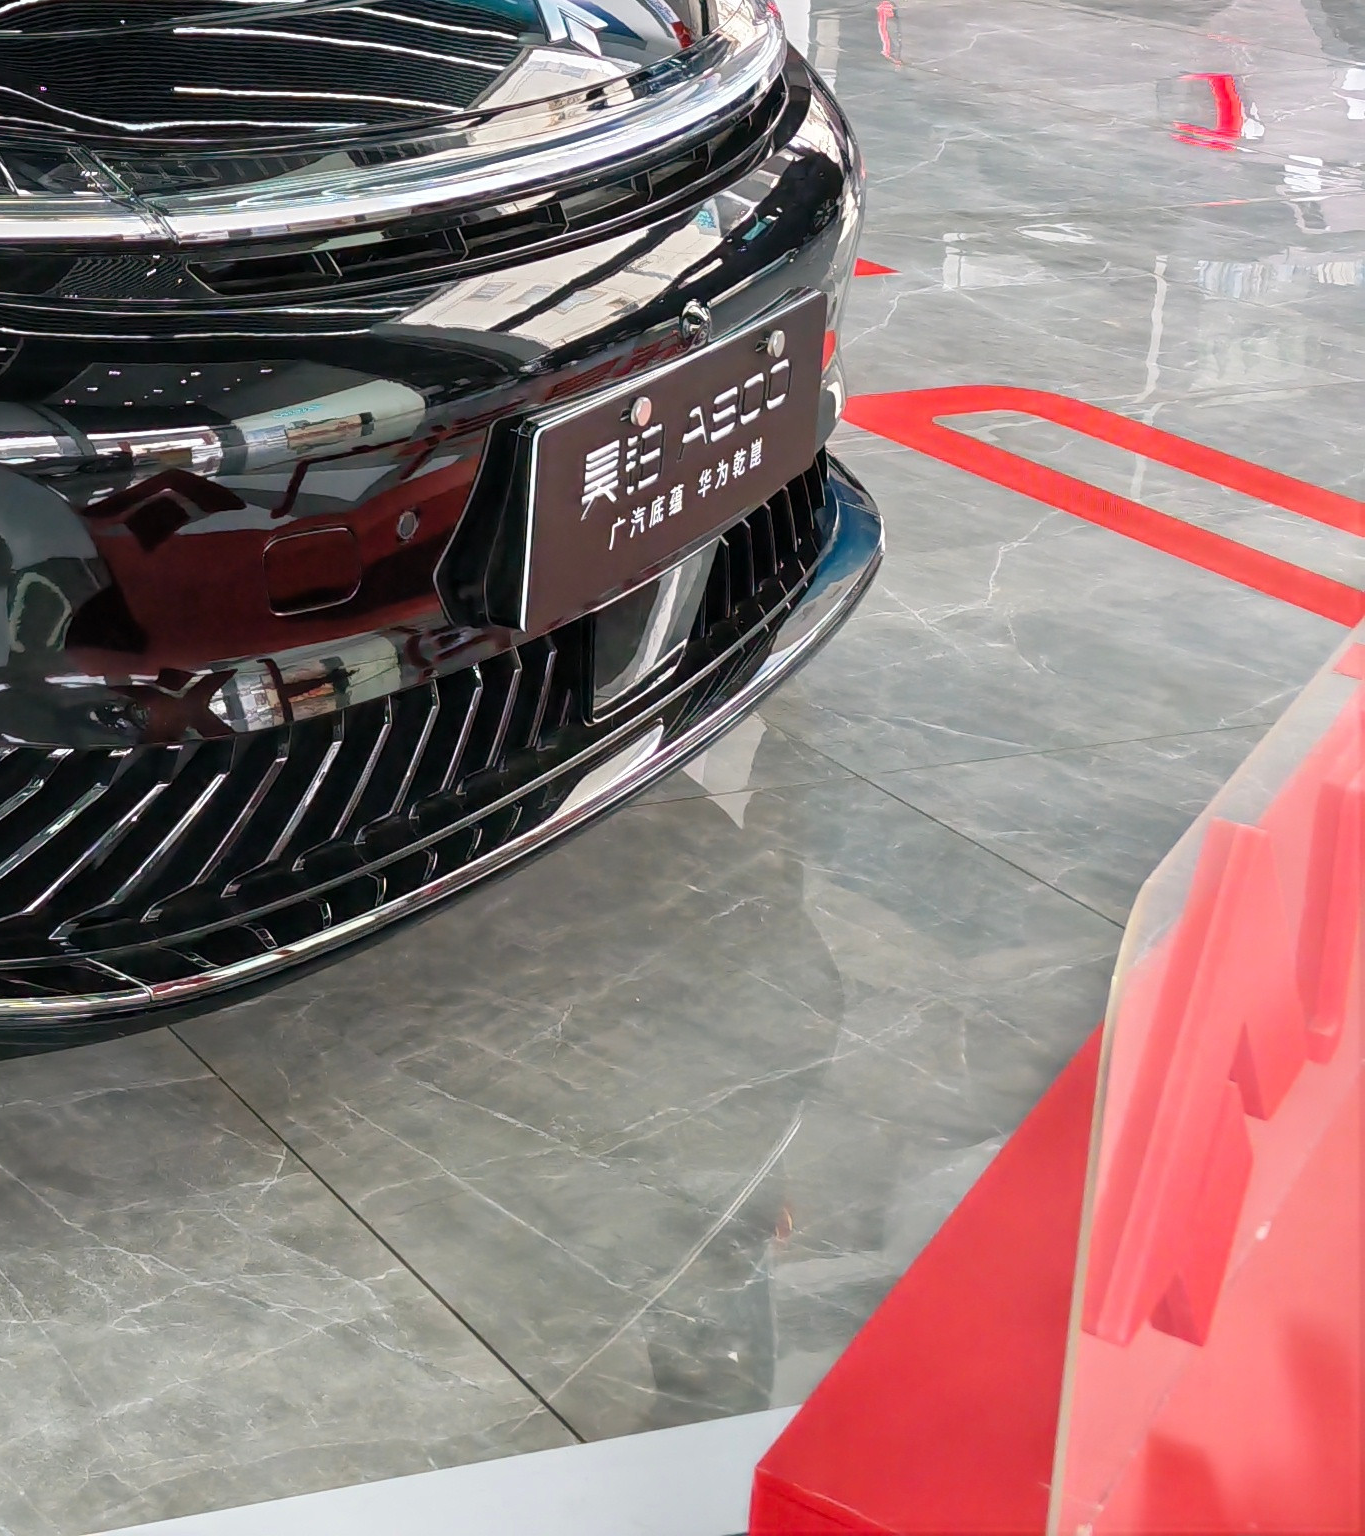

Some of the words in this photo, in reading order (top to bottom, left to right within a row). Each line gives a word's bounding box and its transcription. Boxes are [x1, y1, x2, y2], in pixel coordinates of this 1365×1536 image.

[608, 482, 686, 551] 广汽底蕴
[697, 436, 764, 498] 华为乾崑
